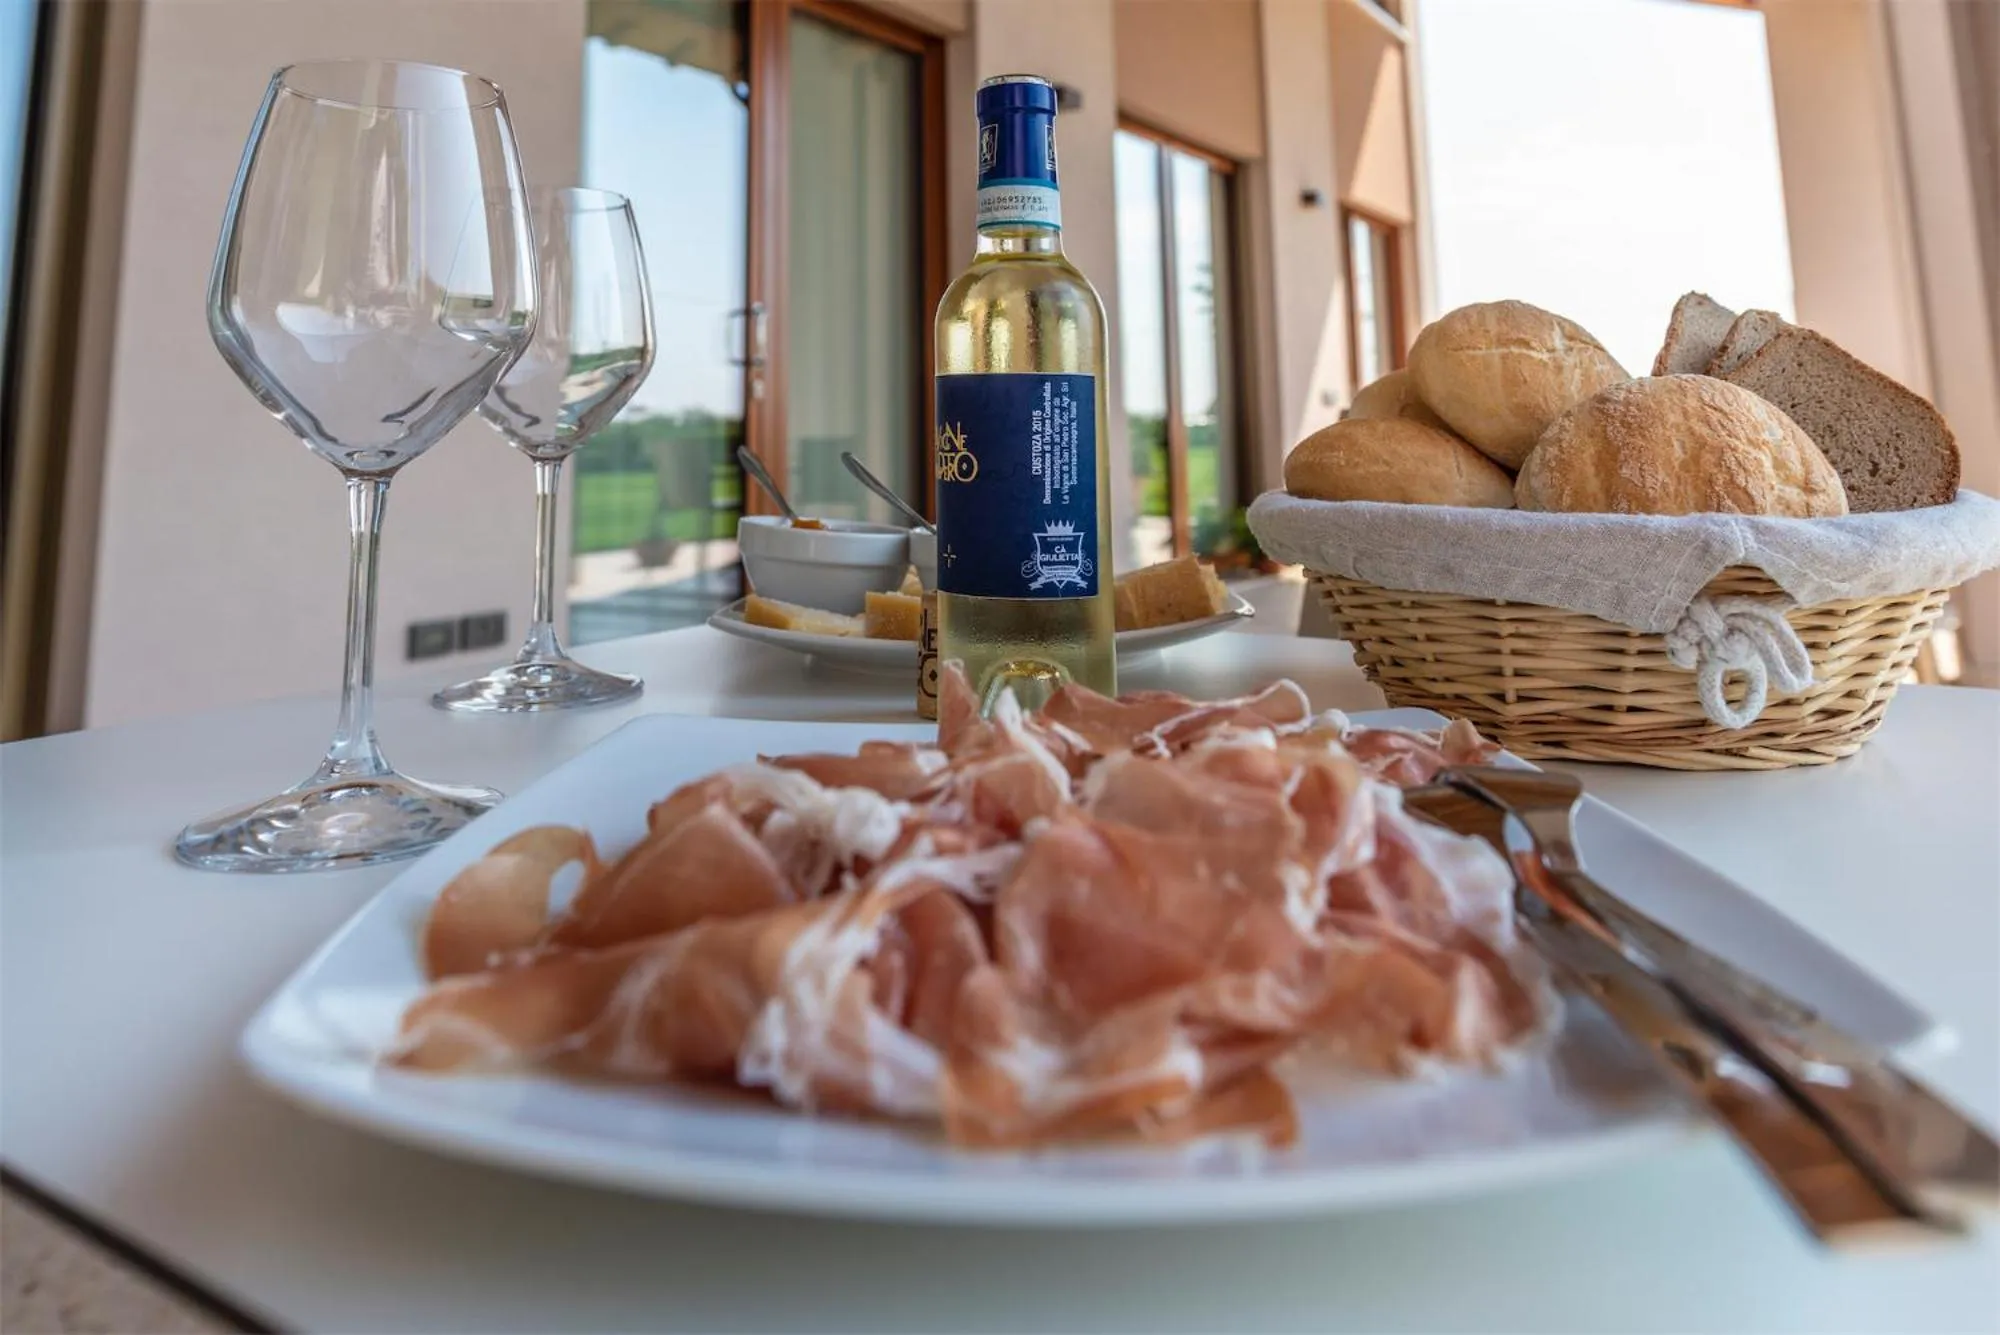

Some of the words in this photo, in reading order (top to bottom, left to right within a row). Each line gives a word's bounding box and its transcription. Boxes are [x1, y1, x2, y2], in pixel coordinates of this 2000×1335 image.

[1032, 410, 1042, 432] 2015
[1061, 426, 1069, 447] Pietro
[1032, 434, 1042, 475] CUSTOZA
[1061, 449, 1069, 463] San
[1061, 473, 1070, 494] Vigne
[1040, 553, 1080, 562] GIULIETTA
